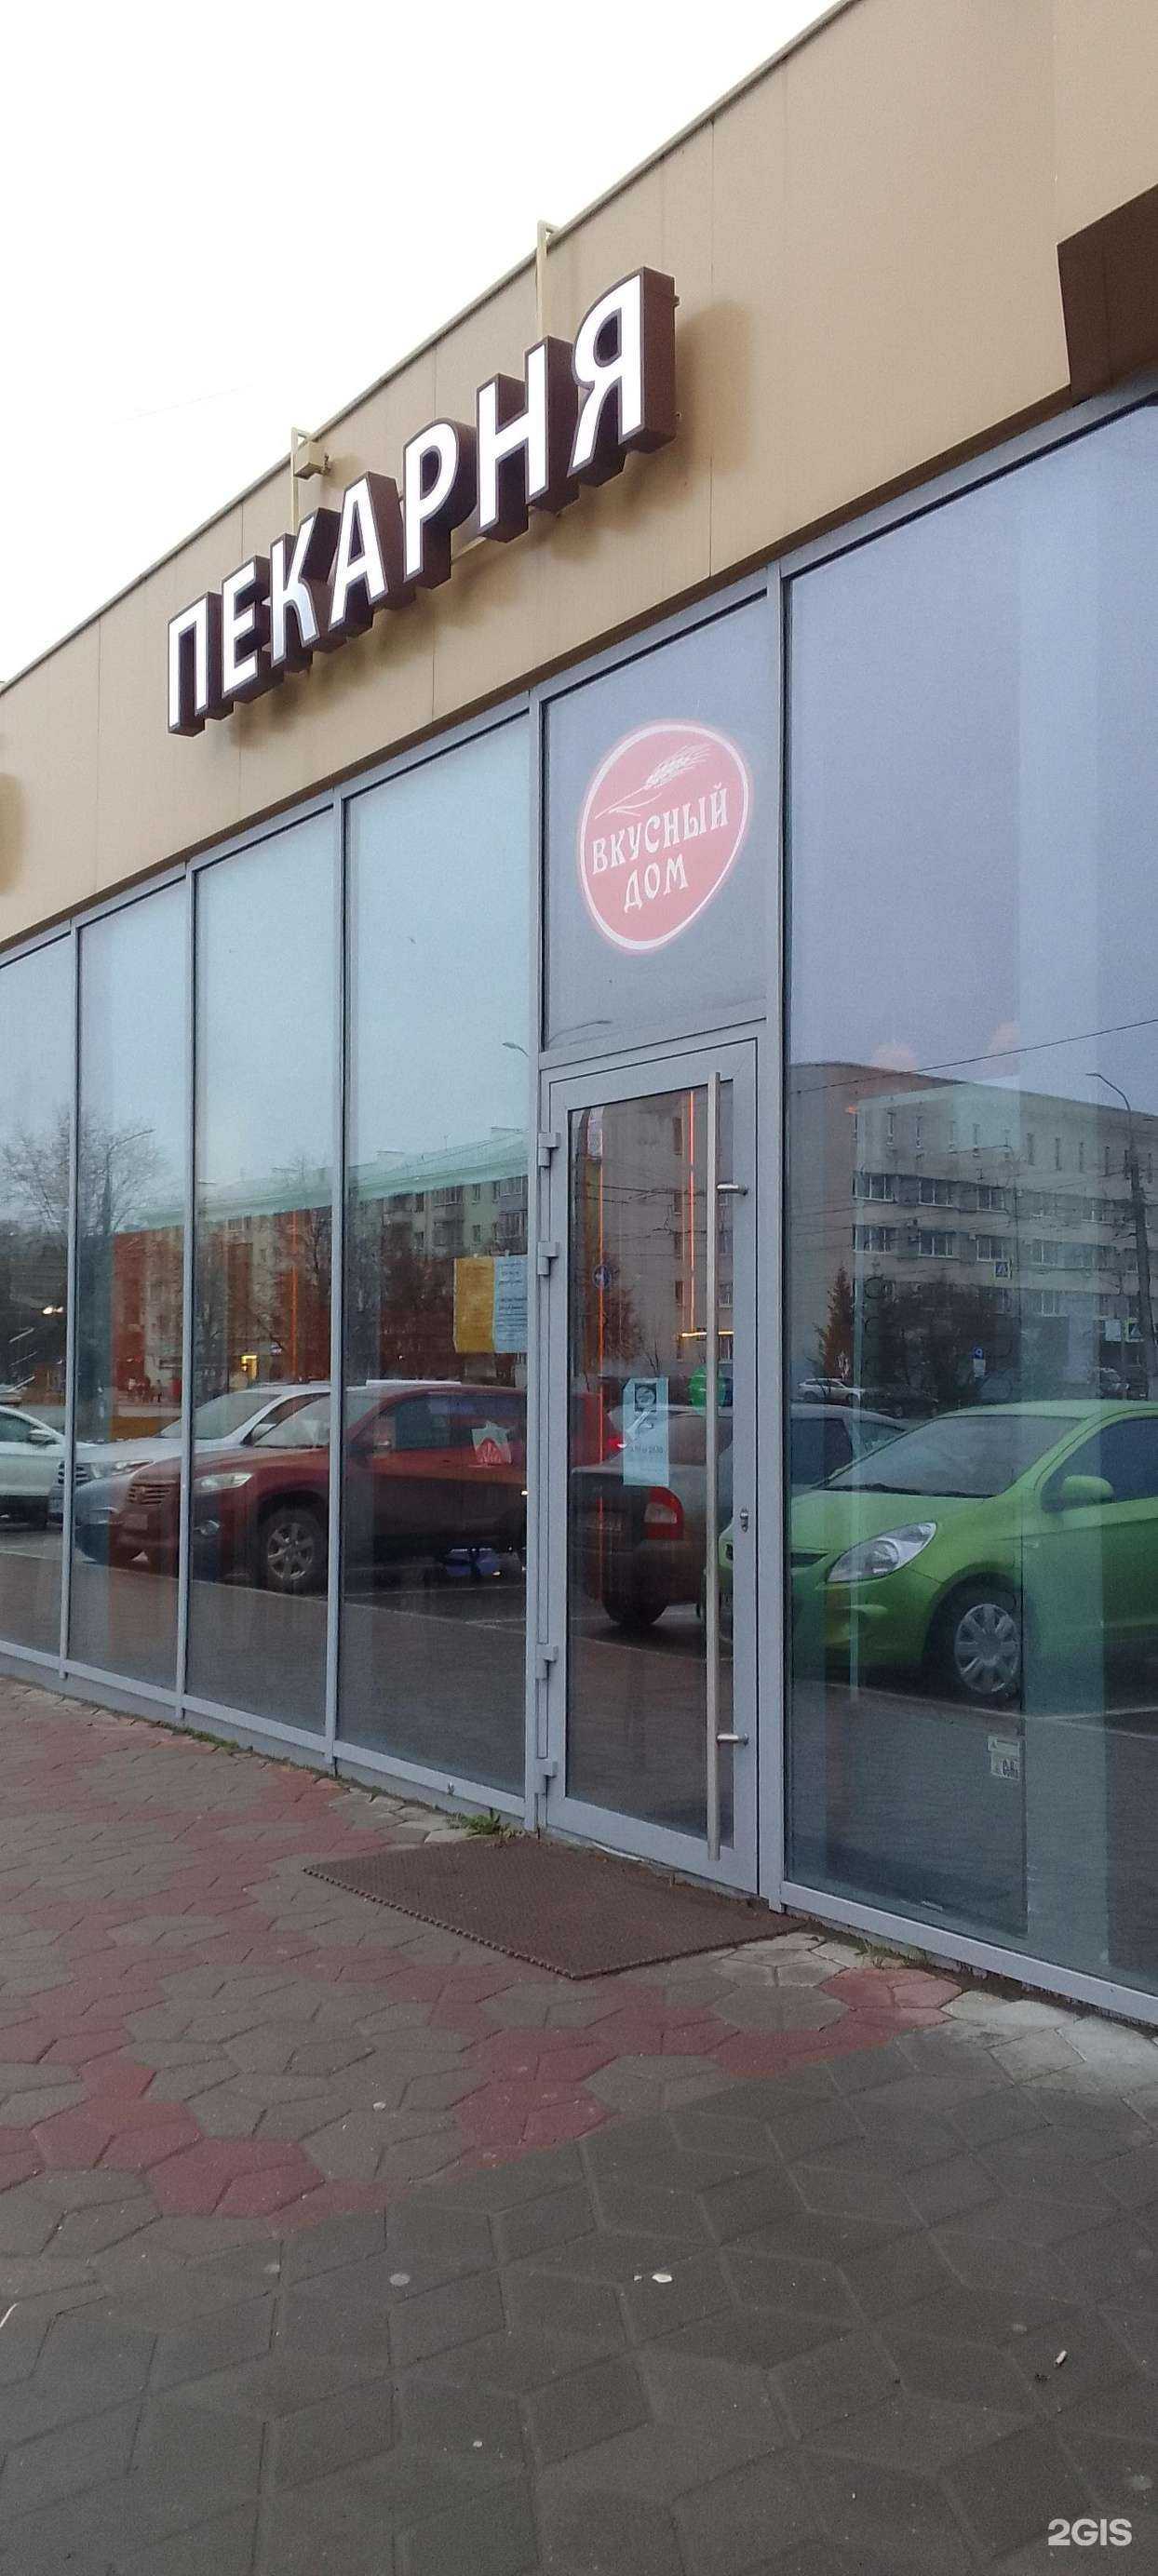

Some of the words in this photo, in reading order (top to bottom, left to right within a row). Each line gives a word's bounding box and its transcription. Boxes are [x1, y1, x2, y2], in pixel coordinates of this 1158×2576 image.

[168, 266, 654, 735] ПЕКАРНЯ
[592, 782, 729, 875] ВКУСНЫЙ
[624, 853, 689, 913] ДОМ
